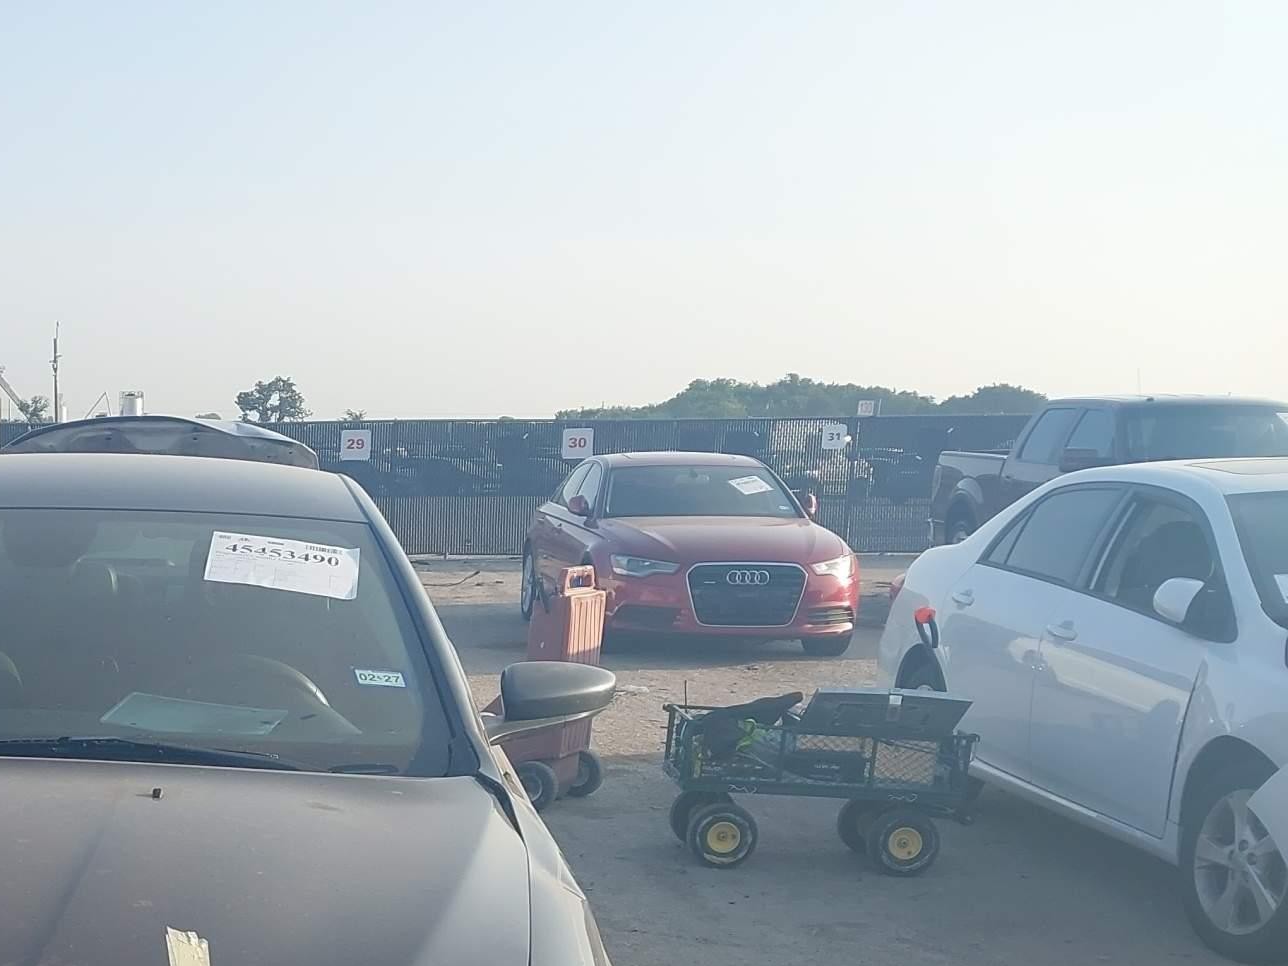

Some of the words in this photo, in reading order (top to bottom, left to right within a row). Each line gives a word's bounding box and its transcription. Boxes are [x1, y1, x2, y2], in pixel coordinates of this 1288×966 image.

[827, 432, 841, 441] 31
[346, 438, 365, 450] 29
[568, 437, 587, 448] 30
[225, 543, 340, 567] 45453490
